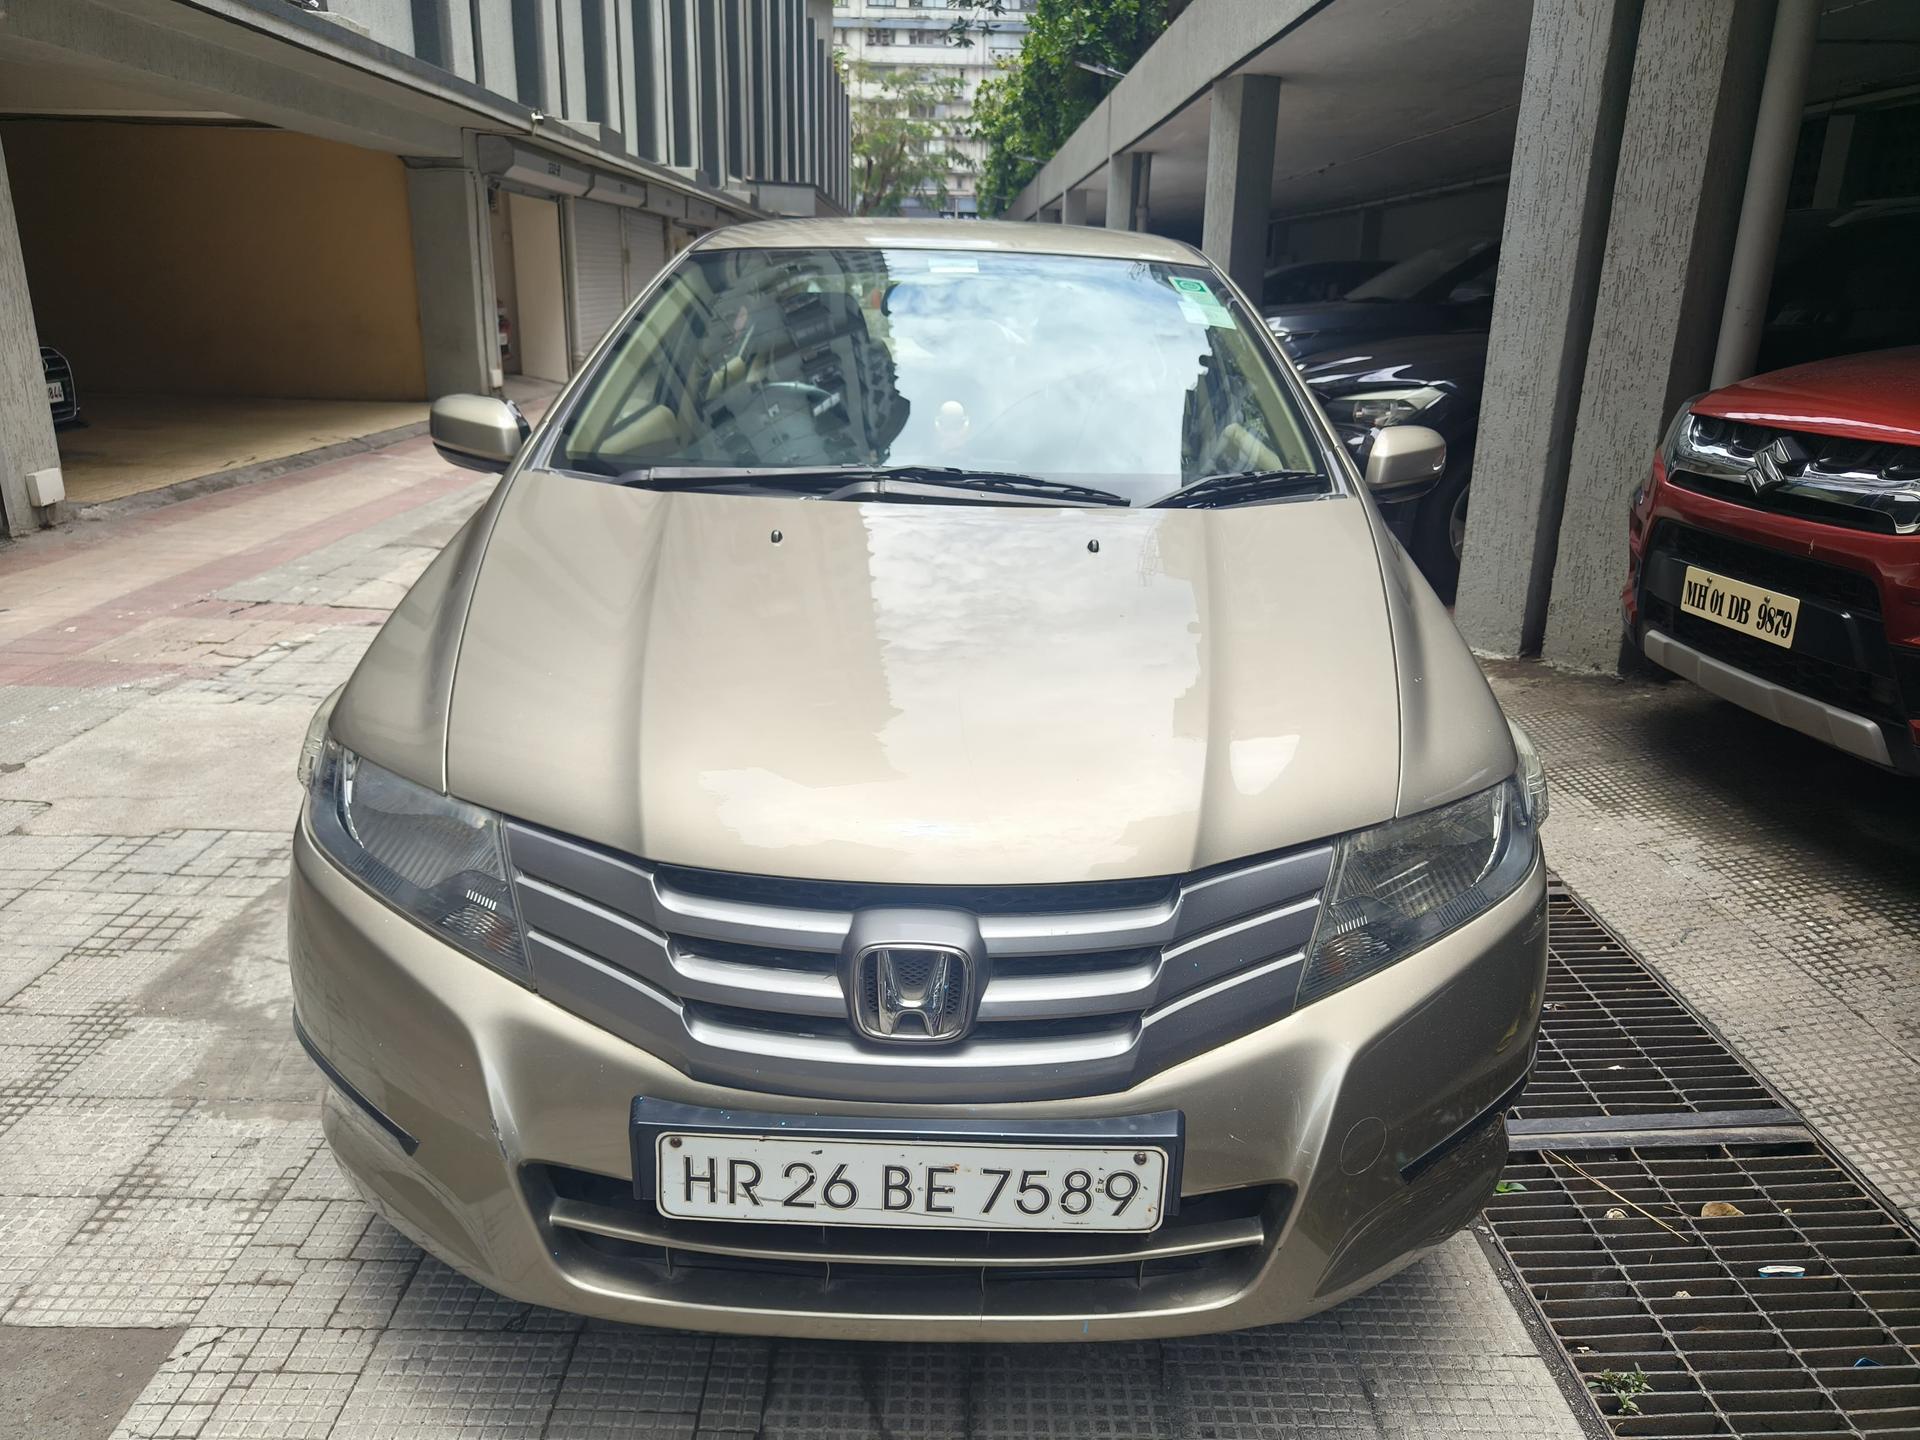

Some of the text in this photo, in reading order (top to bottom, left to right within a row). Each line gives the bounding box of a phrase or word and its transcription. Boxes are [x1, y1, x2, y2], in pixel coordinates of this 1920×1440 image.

[1684, 580, 1792, 639] MH 01 DB 9879
[682, 1154, 1141, 1217] HR 26 BE 7589
